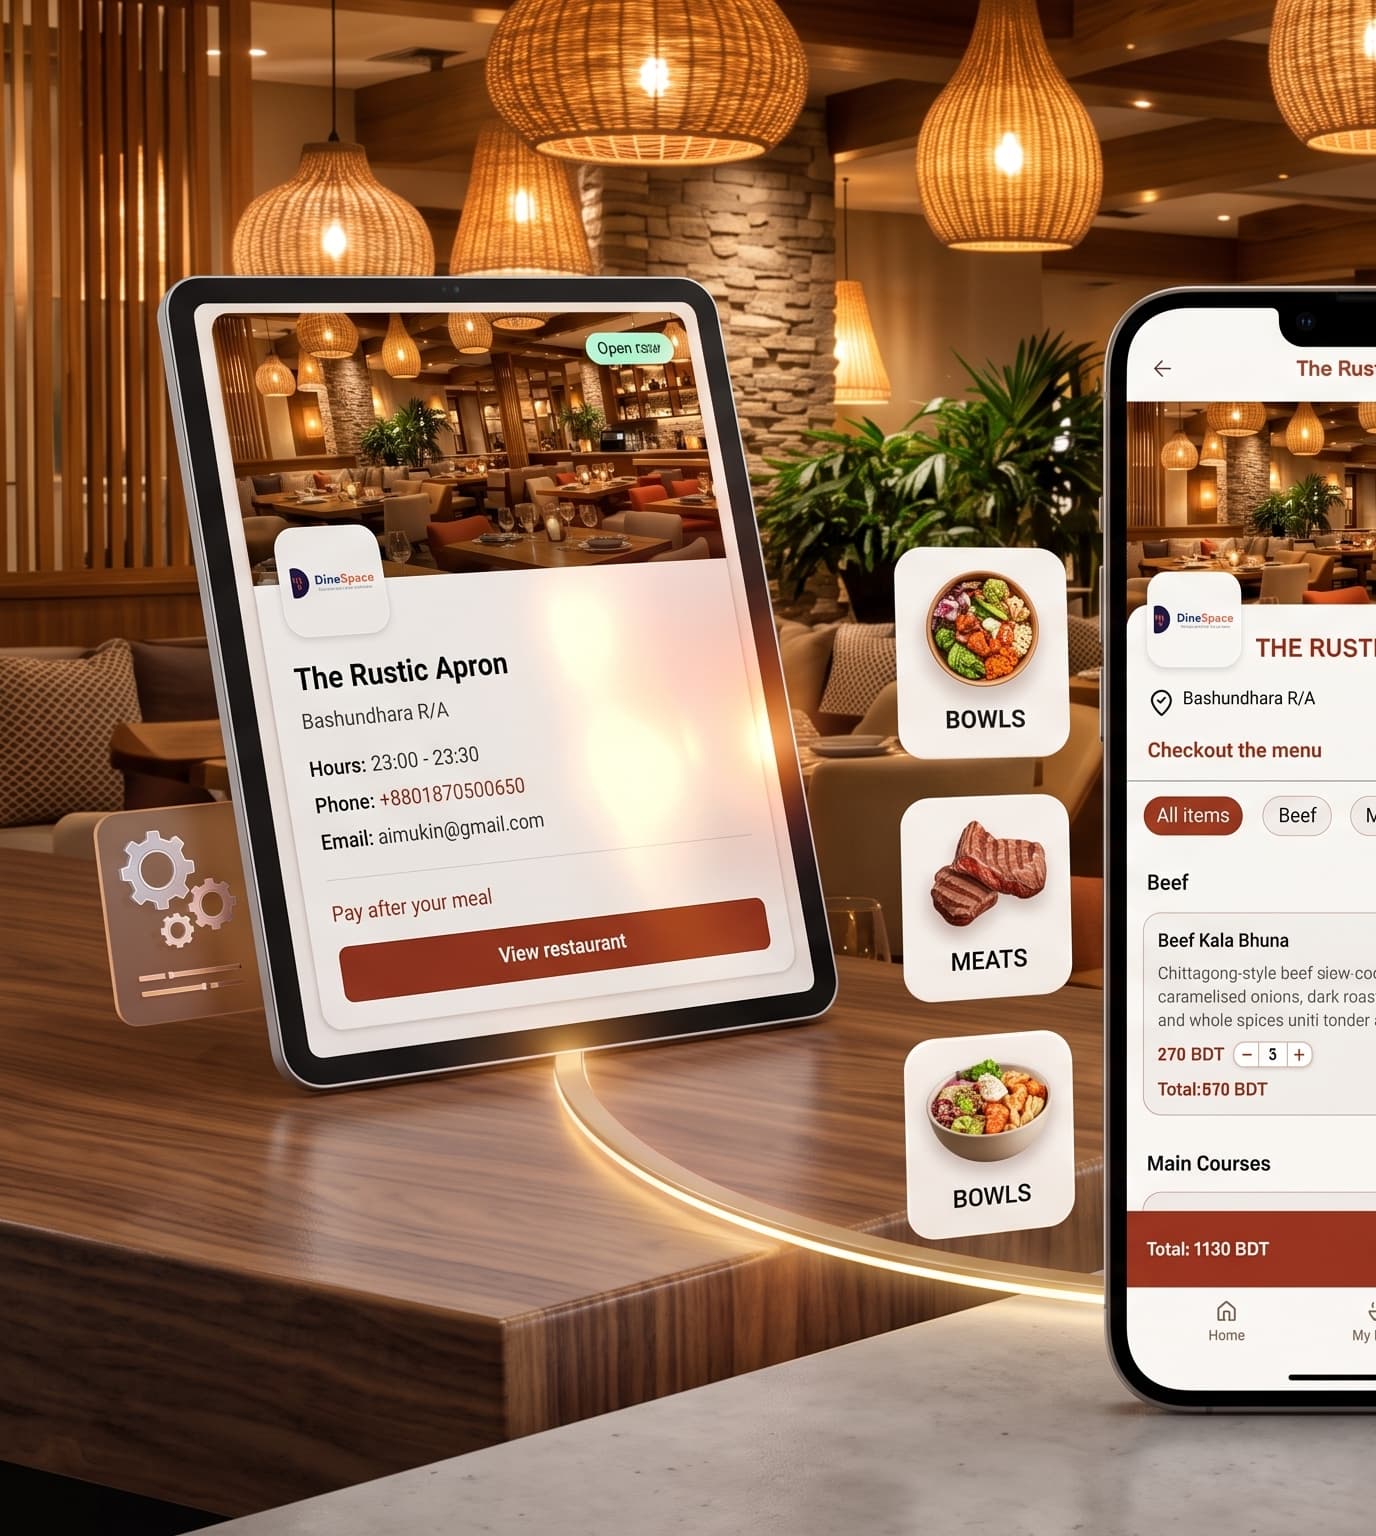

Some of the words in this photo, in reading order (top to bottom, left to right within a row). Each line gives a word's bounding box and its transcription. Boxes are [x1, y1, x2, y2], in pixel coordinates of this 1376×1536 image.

[598, 342, 632, 357] Open
[1296, 360, 1332, 377] The
[315, 573, 374, 585] DineSpace
[1177, 613, 1233, 624] DineSpace
[1256, 638, 1303, 657] THE
[294, 665, 344, 691] The
[350, 657, 429, 686] Rustic
[435, 654, 508, 684] Apron
[1183, 690, 1284, 705] Bashundhara
[1288, 690, 1316, 707] R/A
[301, 704, 413, 730] Bashundhara
[418, 701, 449, 720] R/A
[945, 708, 1026, 731] BOWLS
[1148, 741, 1233, 758] Checkout
[1238, 741, 1267, 758] the
[1272, 745, 1322, 758] menu
[310, 758, 366, 777] Hours:
[371, 751, 419, 772] 23:00
[432, 745, 480, 766] 23:30
[315, 794, 375, 814] Phone:
[380, 776, 525, 807] +8801870500650
[1157, 807, 1178, 822] All
[1183, 807, 1230, 822] items
[1279, 807, 1317, 823] Beef
[321, 830, 374, 851] Email:
[378, 813, 545, 845] aimukin@gmail.com
[1147, 874, 1189, 890] Beef
[332, 904, 363, 926] Pay
[368, 898, 407, 919] after
[411, 895, 448, 917] your
[451, 888, 493, 909] meal
[498, 944, 539, 963] View
[544, 933, 627, 958] restaurant
[1158, 933, 1195, 948] Beef
[1199, 933, 1234, 948] Kala
[1238, 933, 1289, 948] Bhuna
[951, 947, 1028, 973] MEATS
[1158, 966, 1276, 983] Chittagong-style
[1281, 965, 1312, 980] beef
[1158, 989, 1246, 1003] caramelised
[1251, 990, 1303, 1006] onions,
[1307, 989, 1339, 1003] dark
[1158, 1013, 1185, 1027] and
[1189, 1013, 1233, 1027] whole
[1237, 1014, 1284, 1029] spices
[1158, 1048, 1186, 1061] 270
[1191, 1048, 1224, 1061] BDT
[1234, 1082, 1268, 1096] BDT
[1147, 1156, 1192, 1171] Main
[1197, 1155, 1271, 1172] Courses
[953, 1182, 1032, 1209] BOWLS
[1147, 1242, 1190, 1257] Total:
[1193, 1242, 1231, 1257] 1130
[1235, 1242, 1270, 1257] BDT
[1209, 1330, 1245, 1341] Home
[1352, 1330, 1369, 1343] My
